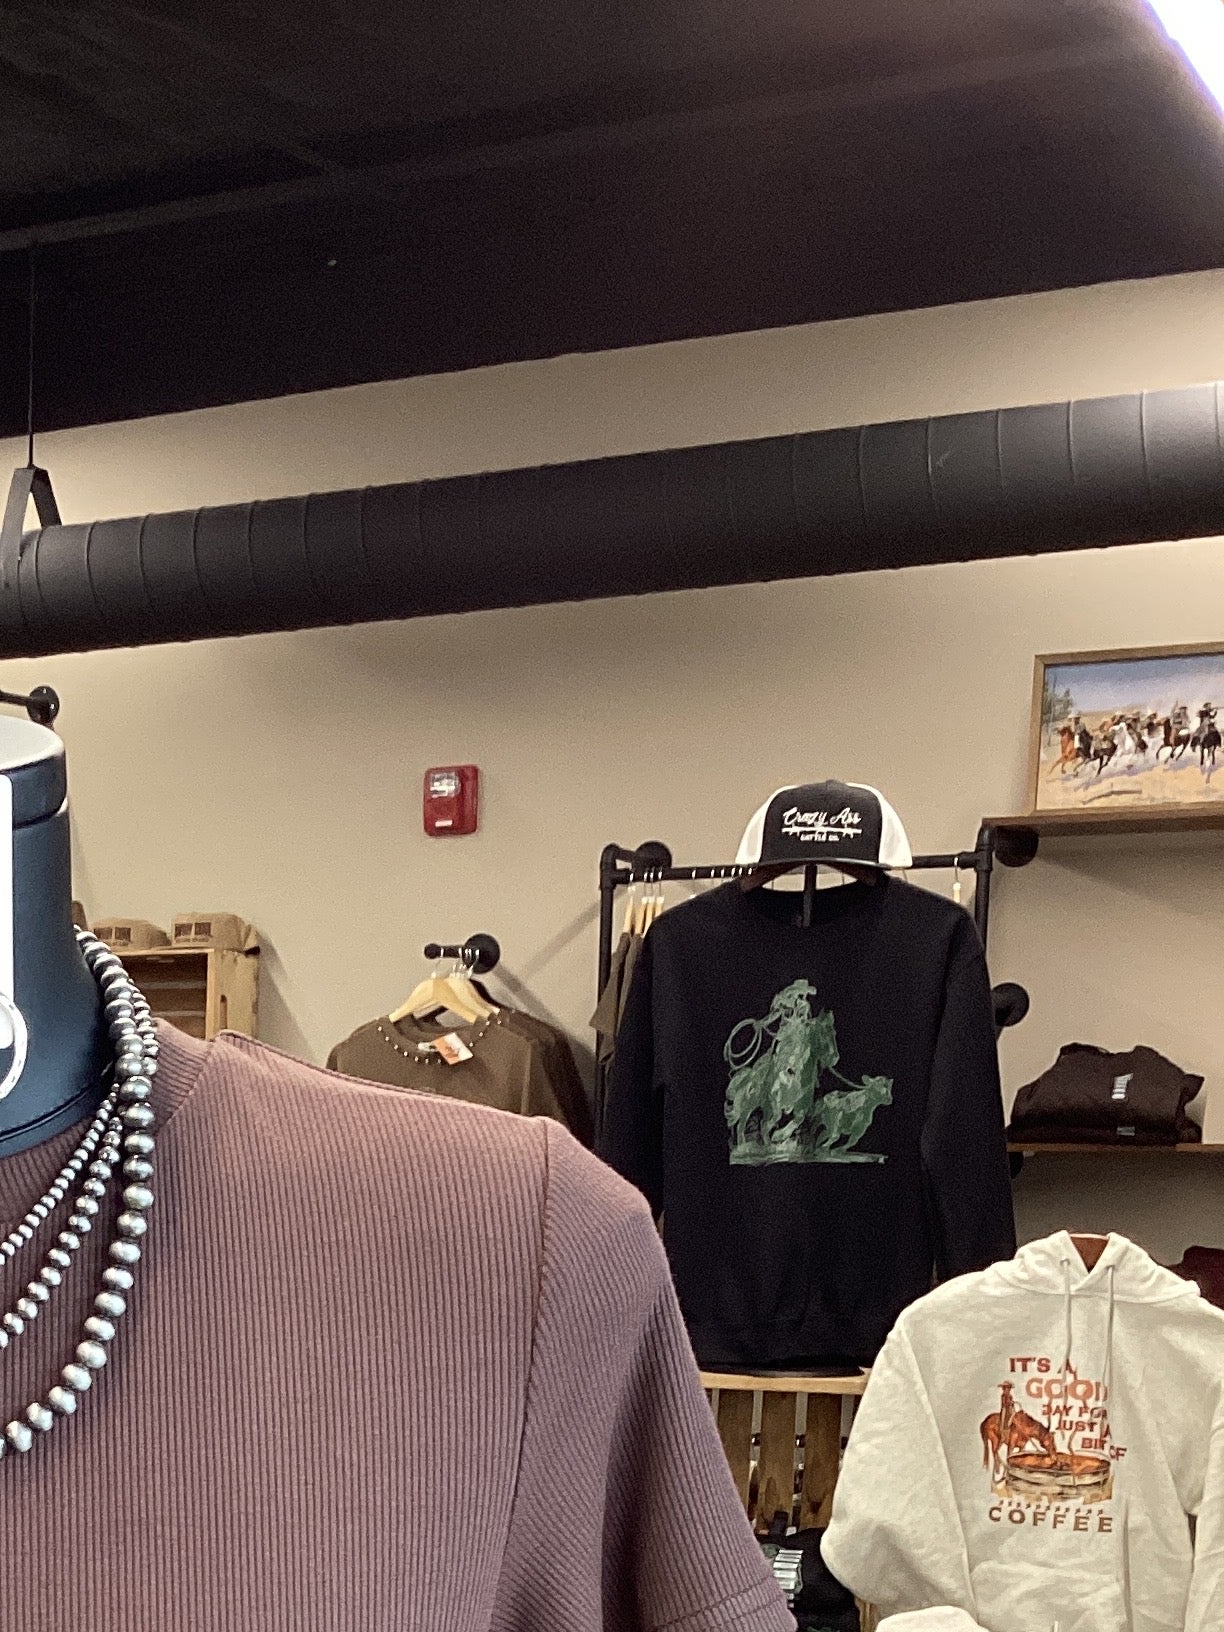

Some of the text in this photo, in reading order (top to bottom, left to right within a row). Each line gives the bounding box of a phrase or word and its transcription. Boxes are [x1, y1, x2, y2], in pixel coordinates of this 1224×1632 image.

[782, 806, 829, 828] Crazy
[1009, 1357, 1051, 1373] IT'S
[988, 1506, 1113, 1533] COFFEE
